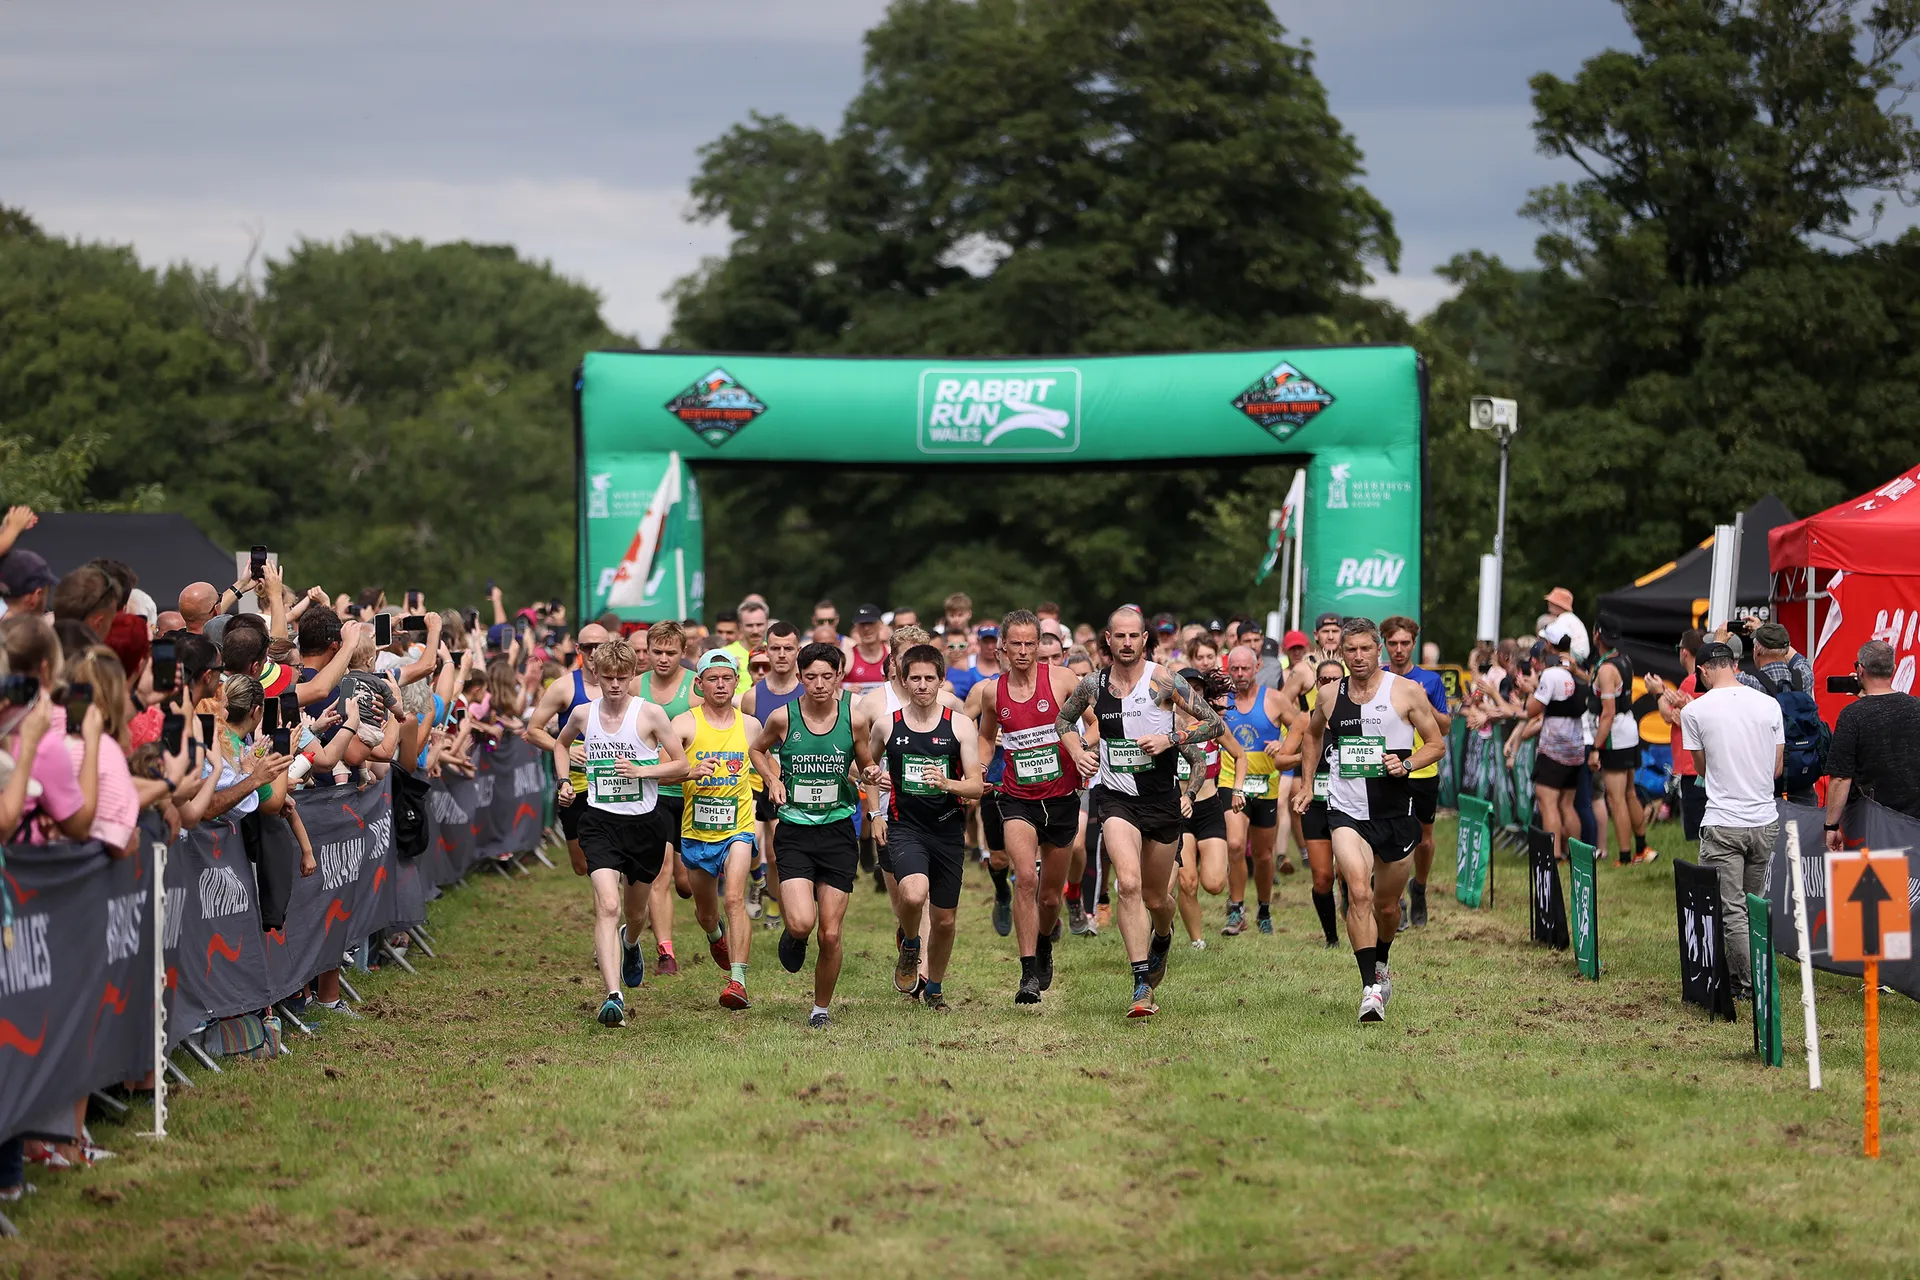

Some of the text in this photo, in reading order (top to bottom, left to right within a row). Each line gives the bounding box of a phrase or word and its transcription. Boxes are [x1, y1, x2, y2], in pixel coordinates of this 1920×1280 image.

[935, 378, 1057, 402] RABBIT
[929, 403, 1001, 426] RUN
[929, 428, 982, 442] WALES
[1102, 711, 1141, 720] PONTYPRIDD
[1341, 718, 1381, 727] PONTYPRIDD
[590, 742, 634, 751] SWANSEA
[1018, 737, 1044, 747] NEWPORT
[590, 751, 636, 759] HARRIERS
[696, 751, 744, 760] CAFFEINE
[792, 755, 845, 763] PORTHCAWL
[1019, 757, 1054, 768] THOMAS
[792, 764, 845, 773] RUNNERS
[696, 776, 738, 786] CARDIO
[700, 807, 730, 815] ASHLEY
